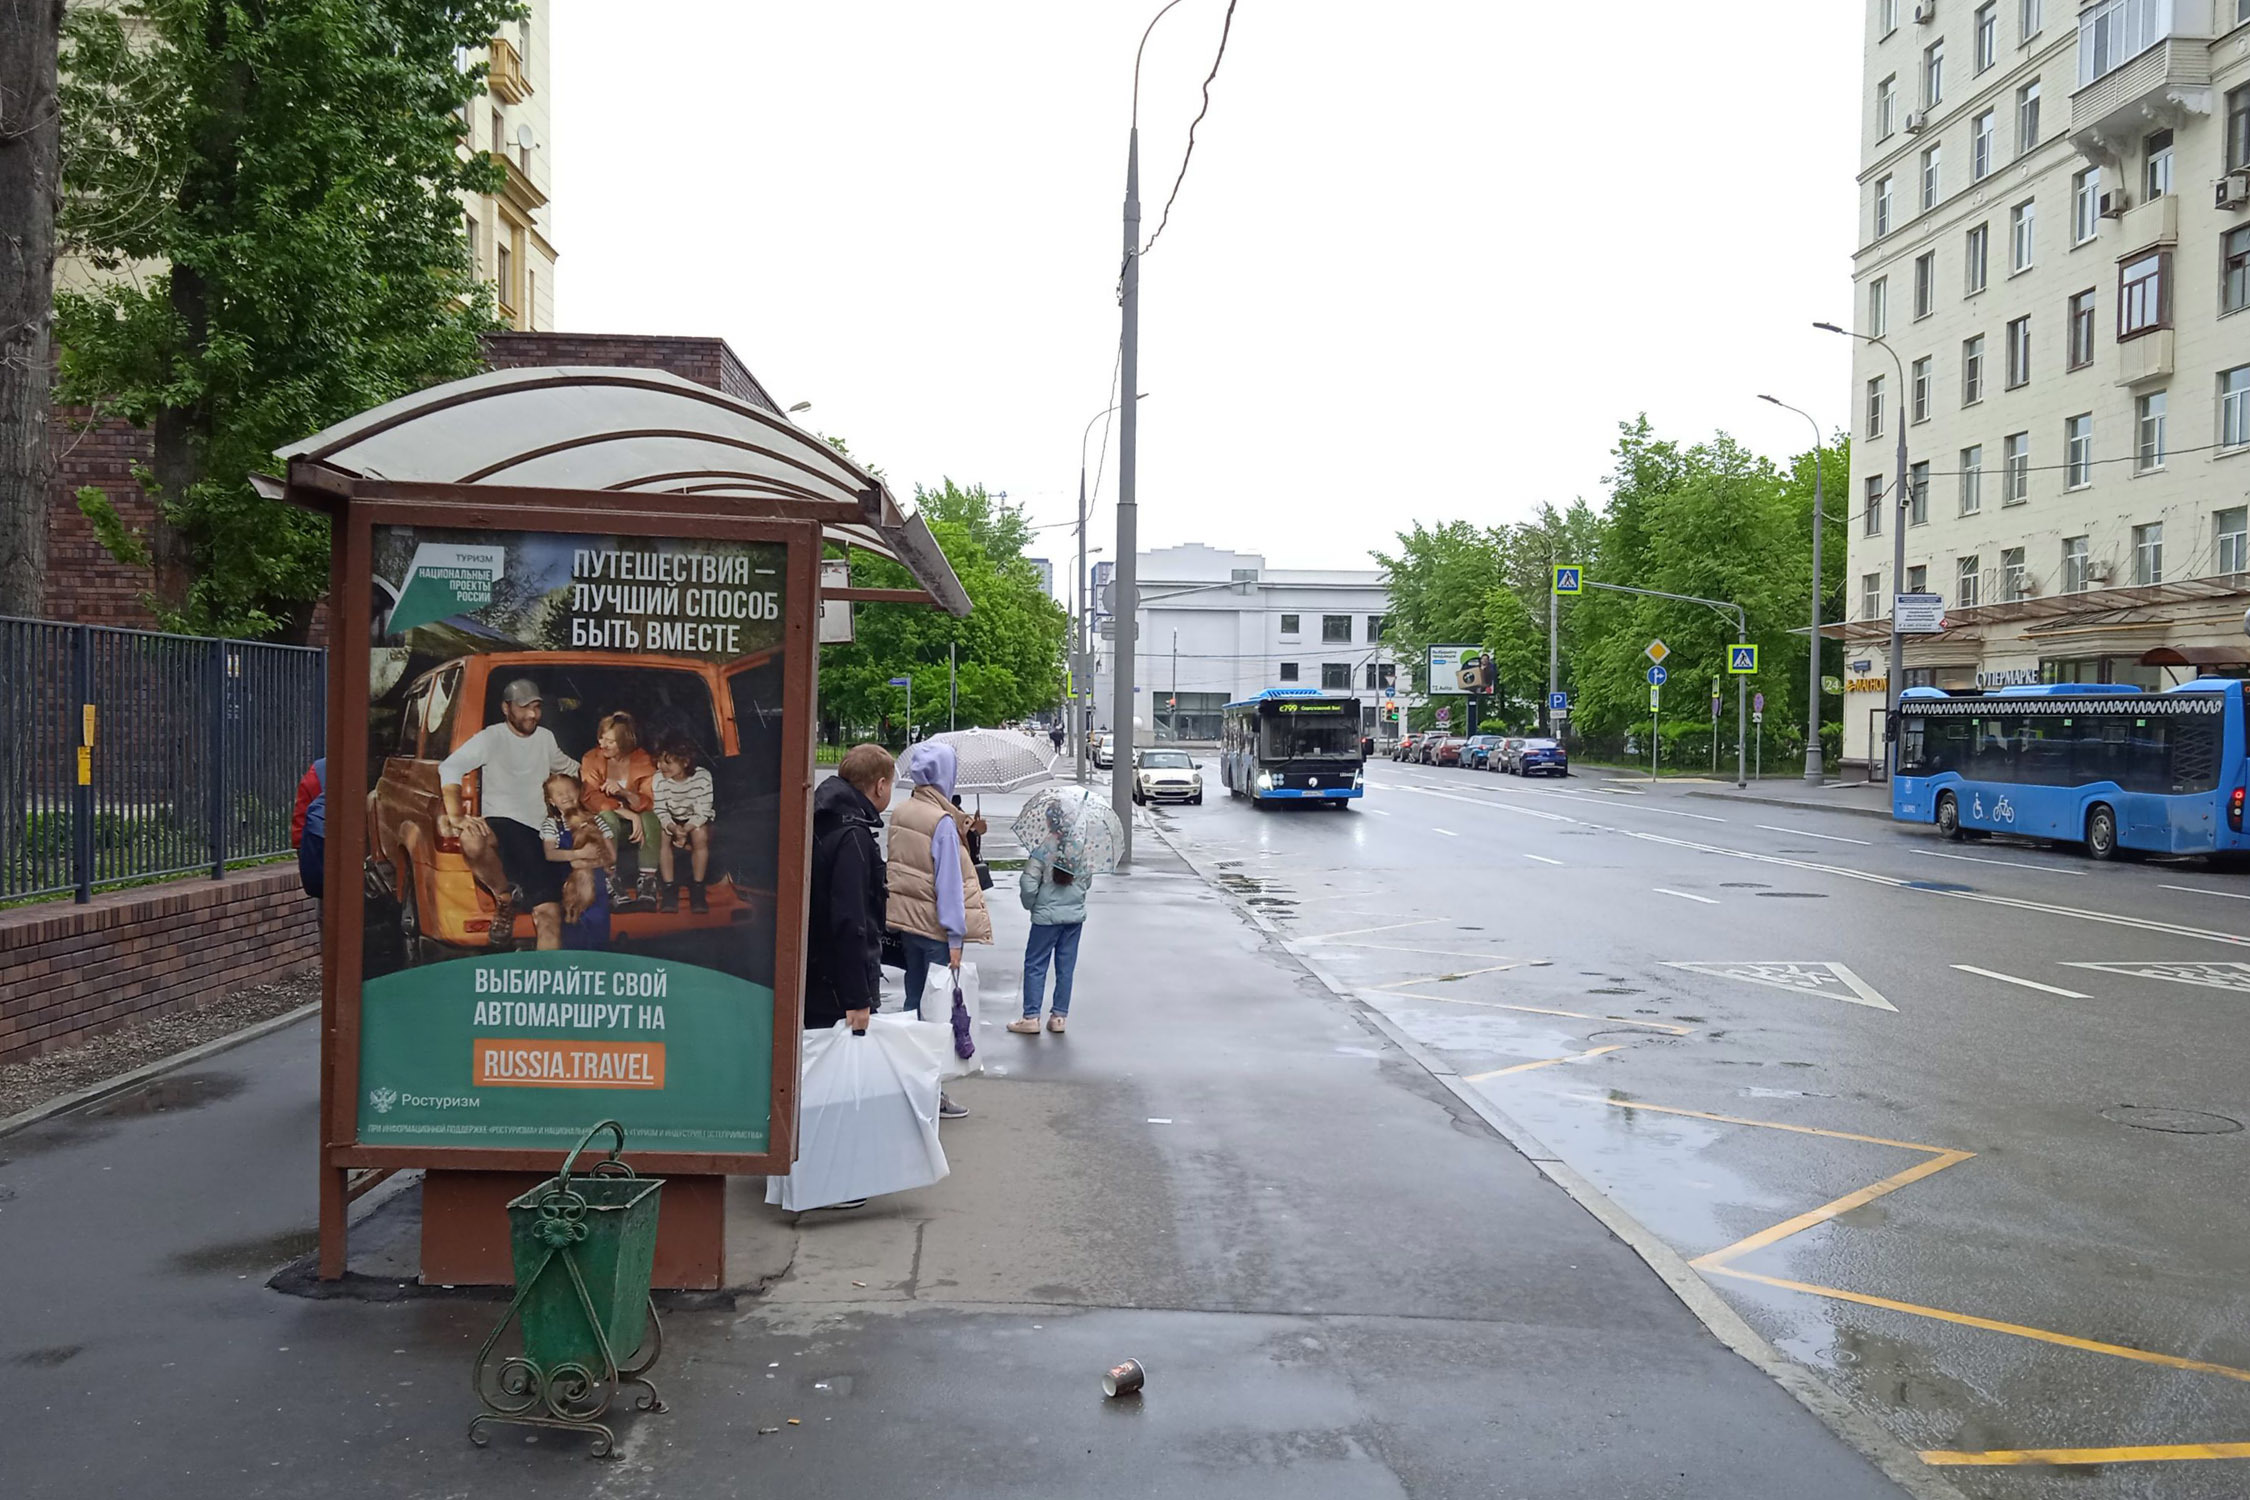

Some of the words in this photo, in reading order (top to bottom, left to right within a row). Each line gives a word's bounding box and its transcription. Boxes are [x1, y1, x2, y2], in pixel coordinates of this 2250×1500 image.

[456, 553, 493, 563] ТУРИЗМ
[573, 549, 749, 585] ПУТЕШЕСТВИЯ
[419, 567, 491, 581] НАЦИОНАЛЬНЫЕ
[449, 579, 491, 592] ПРОЕКТЫ
[456, 591, 491, 603] РОССИИ
[571, 581, 679, 616] ЛУЧШИЙ
[685, 588, 779, 620] СПОСОБ
[572, 617, 640, 649] БЫТЬ
[646, 620, 741, 653] ВМЕСТЕ
[475, 965, 606, 996] ВЫБИРАЙТЕ
[612, 967, 667, 998] СВОЙ
[473, 1001, 633, 1029] АВТОМАРШРУТ
[638, 1004, 666, 1030] НА
[484, 1049, 655, 1080] RUSSIA.TRAVEL
[401, 1093, 480, 1110] Ростуризм
